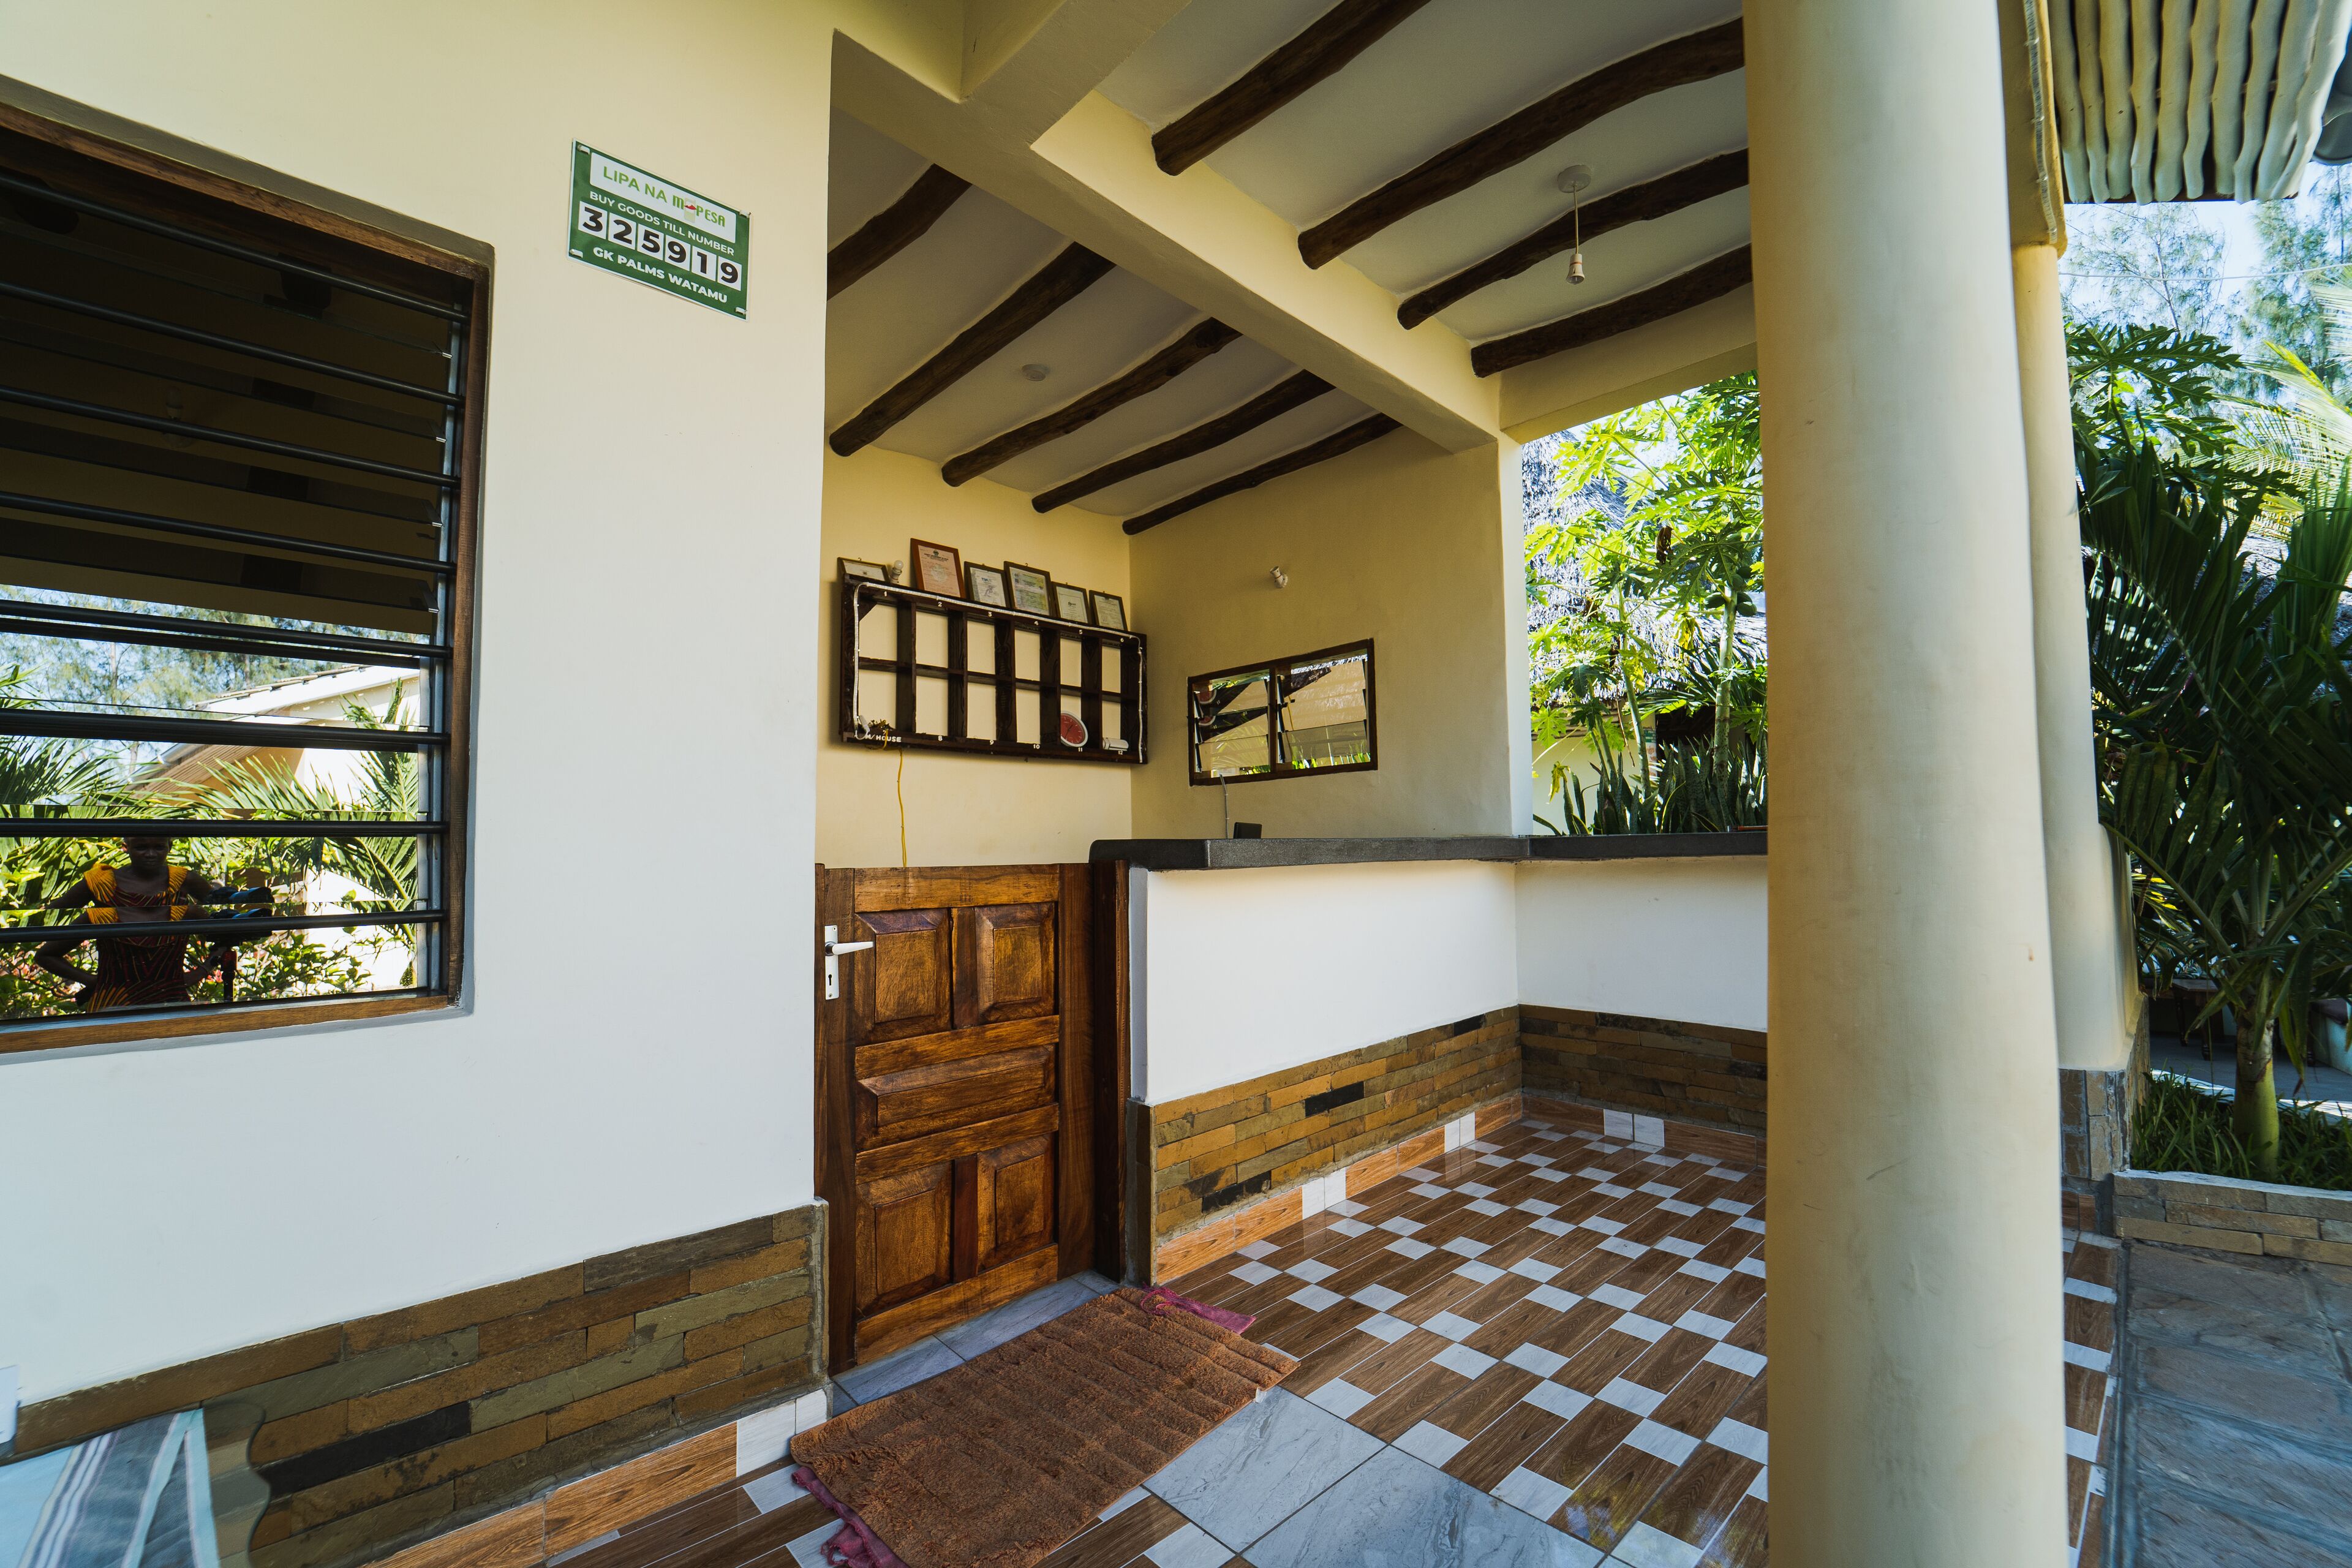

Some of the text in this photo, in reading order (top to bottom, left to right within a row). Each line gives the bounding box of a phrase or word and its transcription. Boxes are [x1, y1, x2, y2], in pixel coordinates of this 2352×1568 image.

[603, 166, 640, 192] LIPA
[645, 183, 668, 203] NA
[582, 206, 739, 284] 325919
[590, 190, 735, 256] BUY GOODS TILL NUMBER
[593, 247, 728, 303] GK PALMS WATAMU
